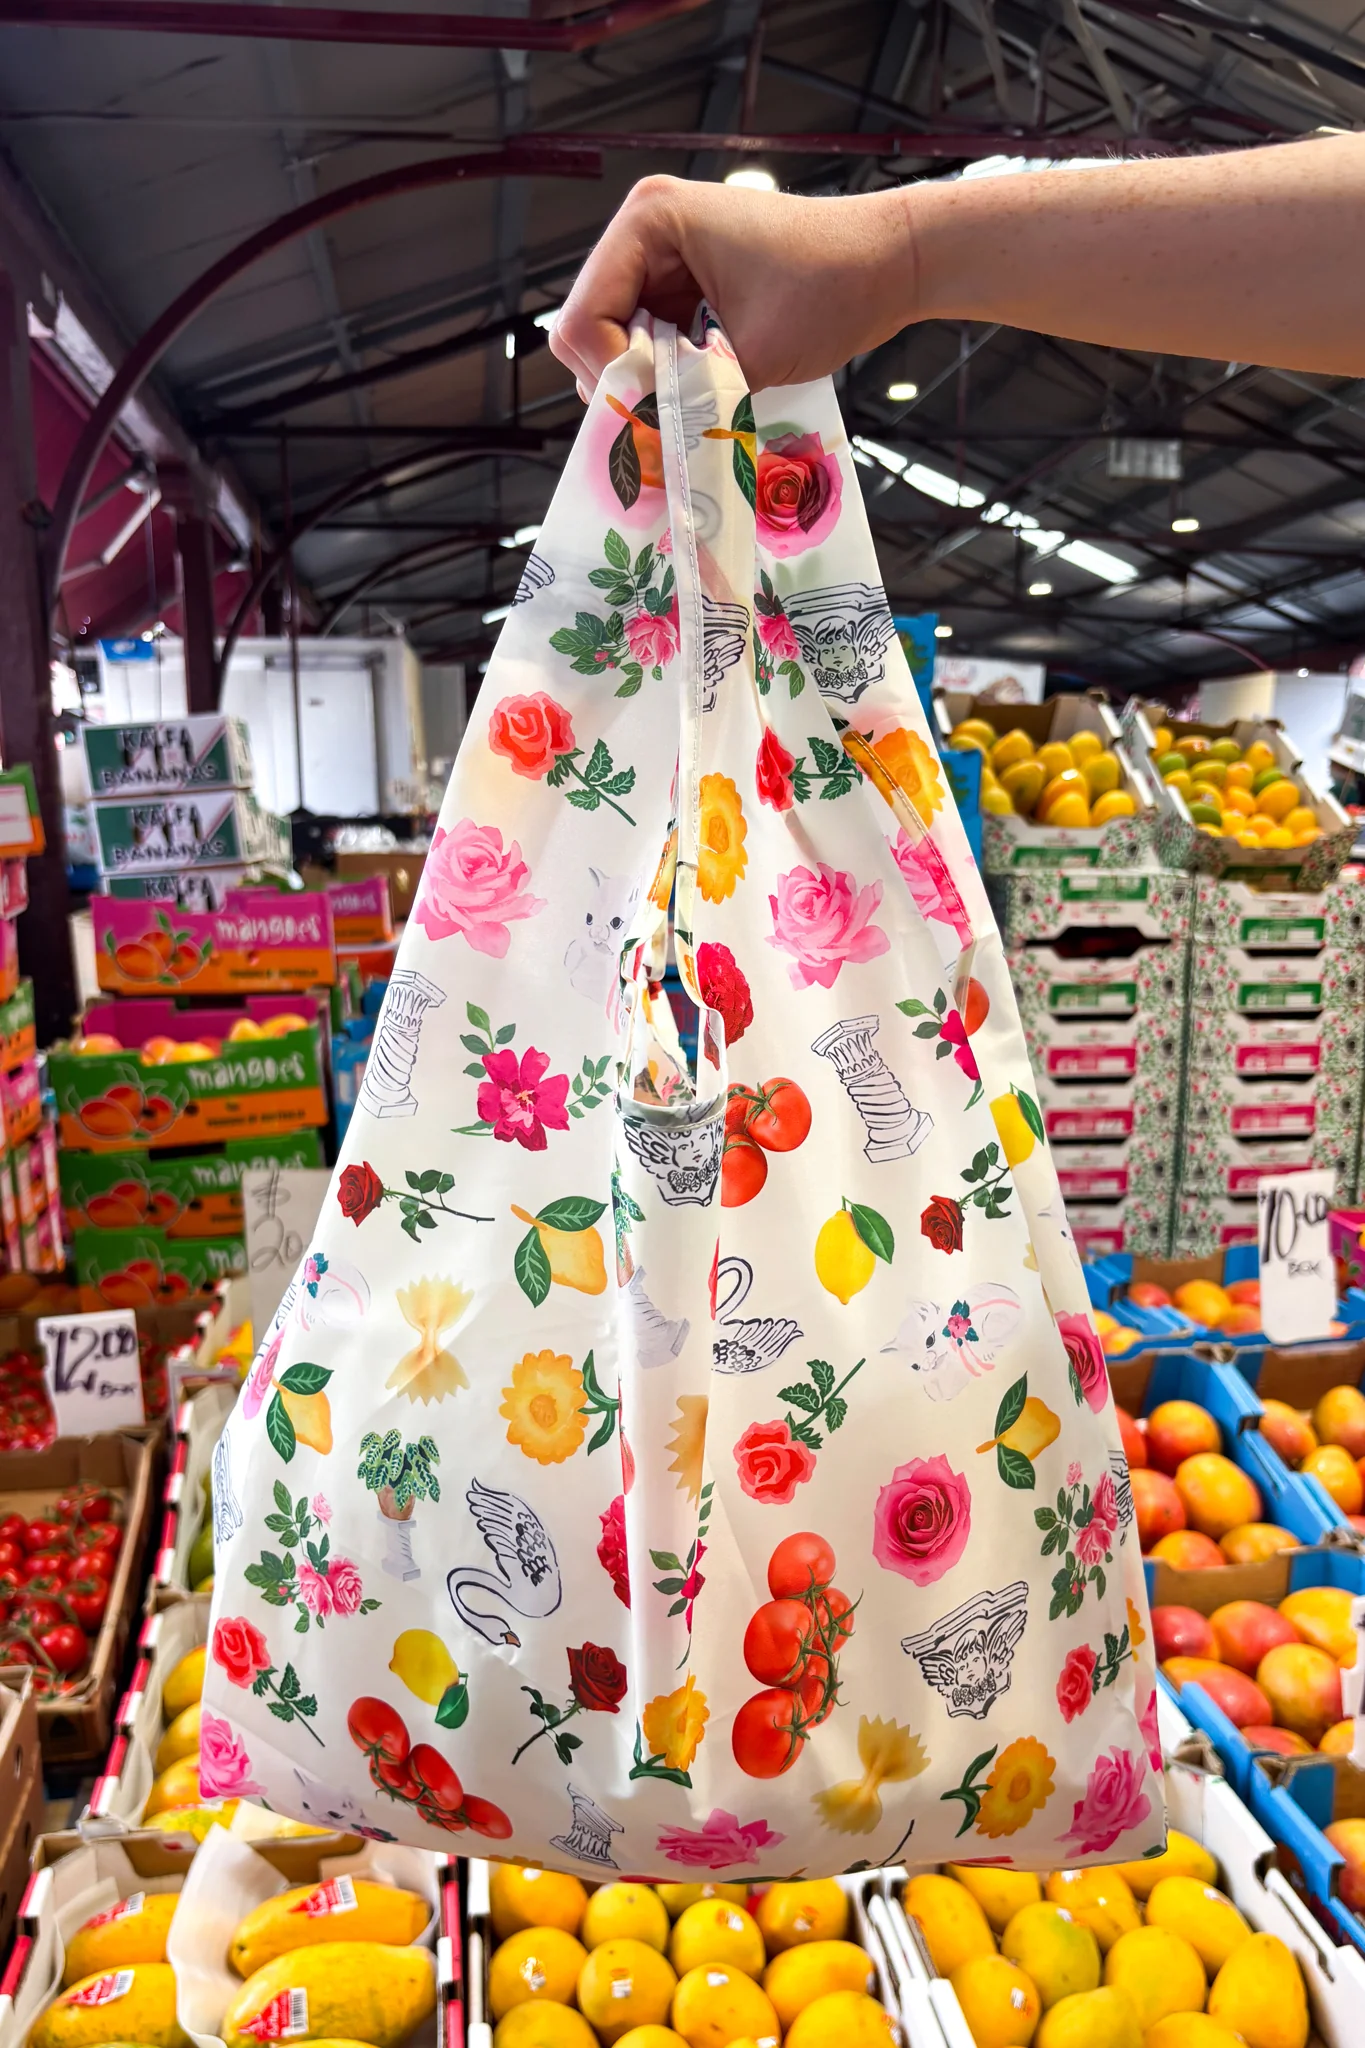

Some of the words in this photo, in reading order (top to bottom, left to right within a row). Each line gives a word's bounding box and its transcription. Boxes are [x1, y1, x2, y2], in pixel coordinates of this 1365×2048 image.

[120, 727, 192, 750] KALFA
[103, 763, 219, 787] BANANAS
[134, 805, 201, 828] KALFA
[115, 840, 226, 863] BANANAS
[216, 915, 322, 945] mangoes
[186, 1053, 306, 1089] mangoes
